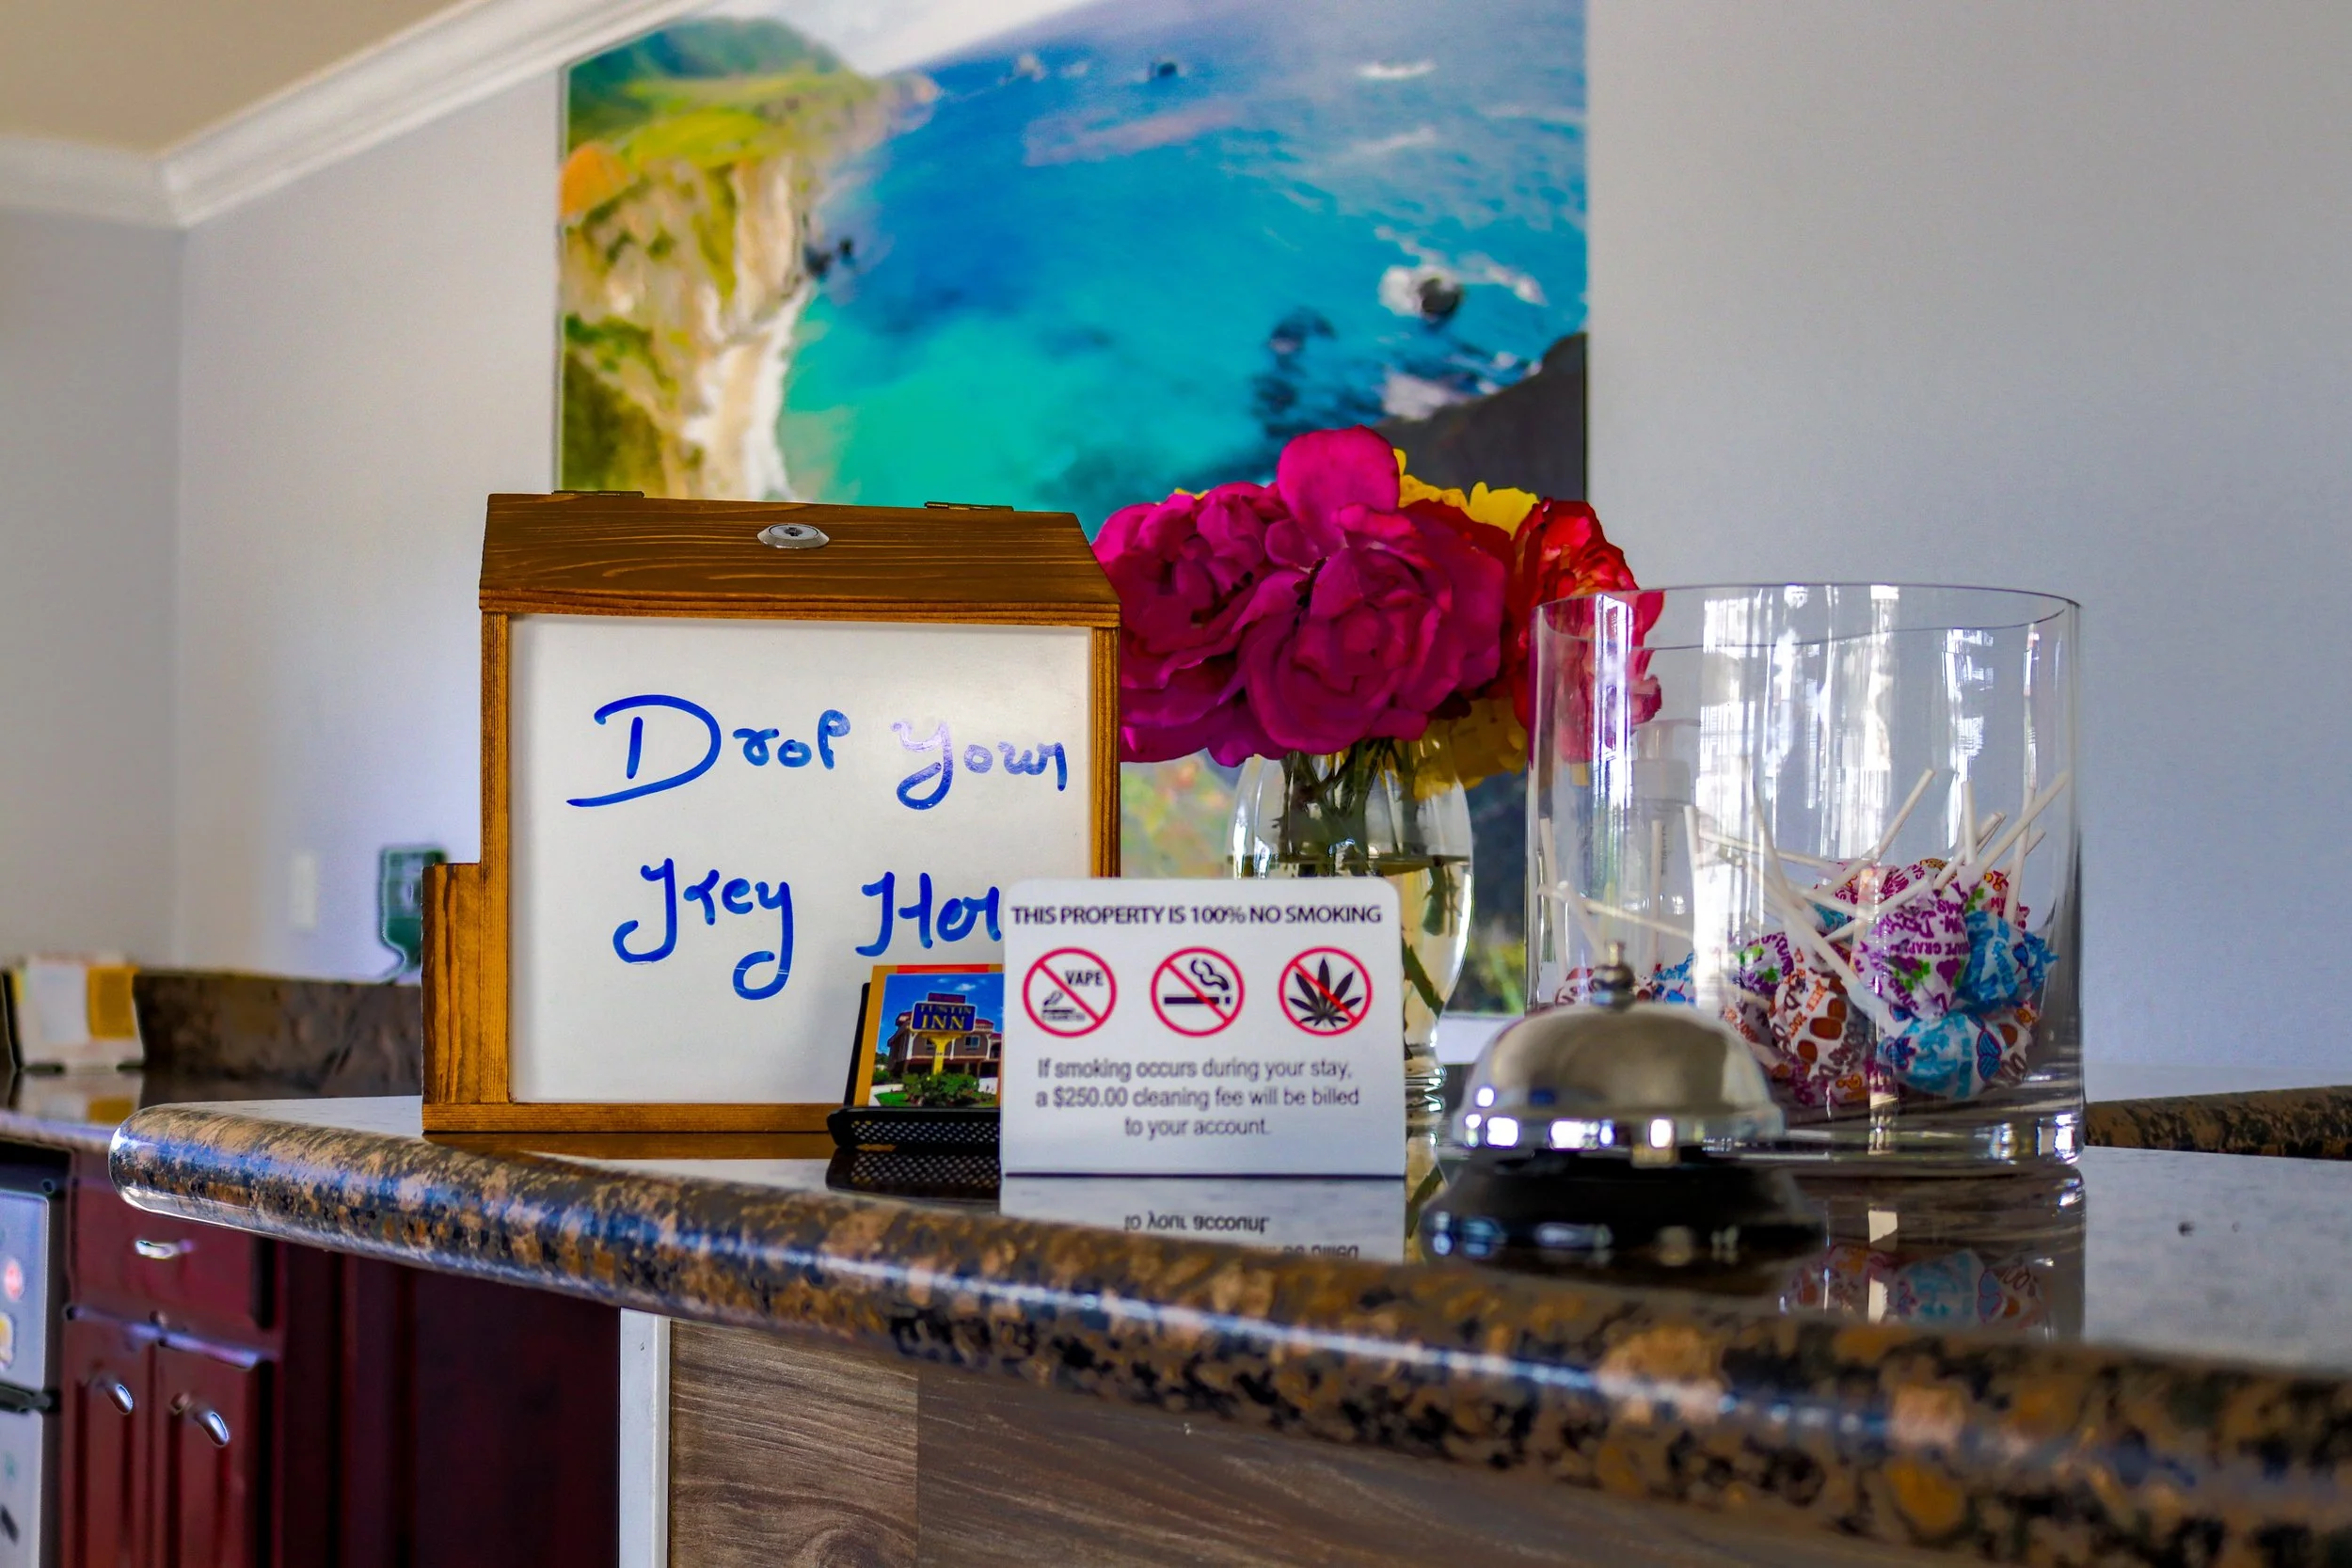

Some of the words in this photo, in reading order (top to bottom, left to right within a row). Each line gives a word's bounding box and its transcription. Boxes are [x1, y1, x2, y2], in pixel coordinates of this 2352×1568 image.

[855, 871, 1002, 957] Her
[1011, 906, 1057, 925] THIS
[1060, 906, 1166, 925] PROPERTY
[1168, 906, 1185, 925] IS
[1192, 906, 1248, 925] 100%
[1250, 906, 1281, 925] NO
[1285, 905, 1382, 925] SMOKING
[1065, 970, 1104, 986] VAPE
[922, 1015, 965, 1029] INN
[1037, 1058, 1051, 1079] If
[1055, 1058, 1132, 1082] smoking
[1136, 1062, 1197, 1079] occurs
[1202, 1057, 1259, 1082] during
[1263, 1062, 1305, 1082] your
[1311, 1059, 1353, 1082] stay,
[1035, 1090, 1048, 1107] a
[1053, 1086, 1128, 1110] $250.00
[1133, 1087, 1210, 1111] cleaning
[1215, 1086, 1244, 1107] fee
[1248, 1087, 1278, 1106] will
[1284, 1087, 1306, 1106] be
[1312, 1087, 1359, 1106] billed
[1124, 1117, 1143, 1136] to
[1148, 1119, 1188, 1141] your
